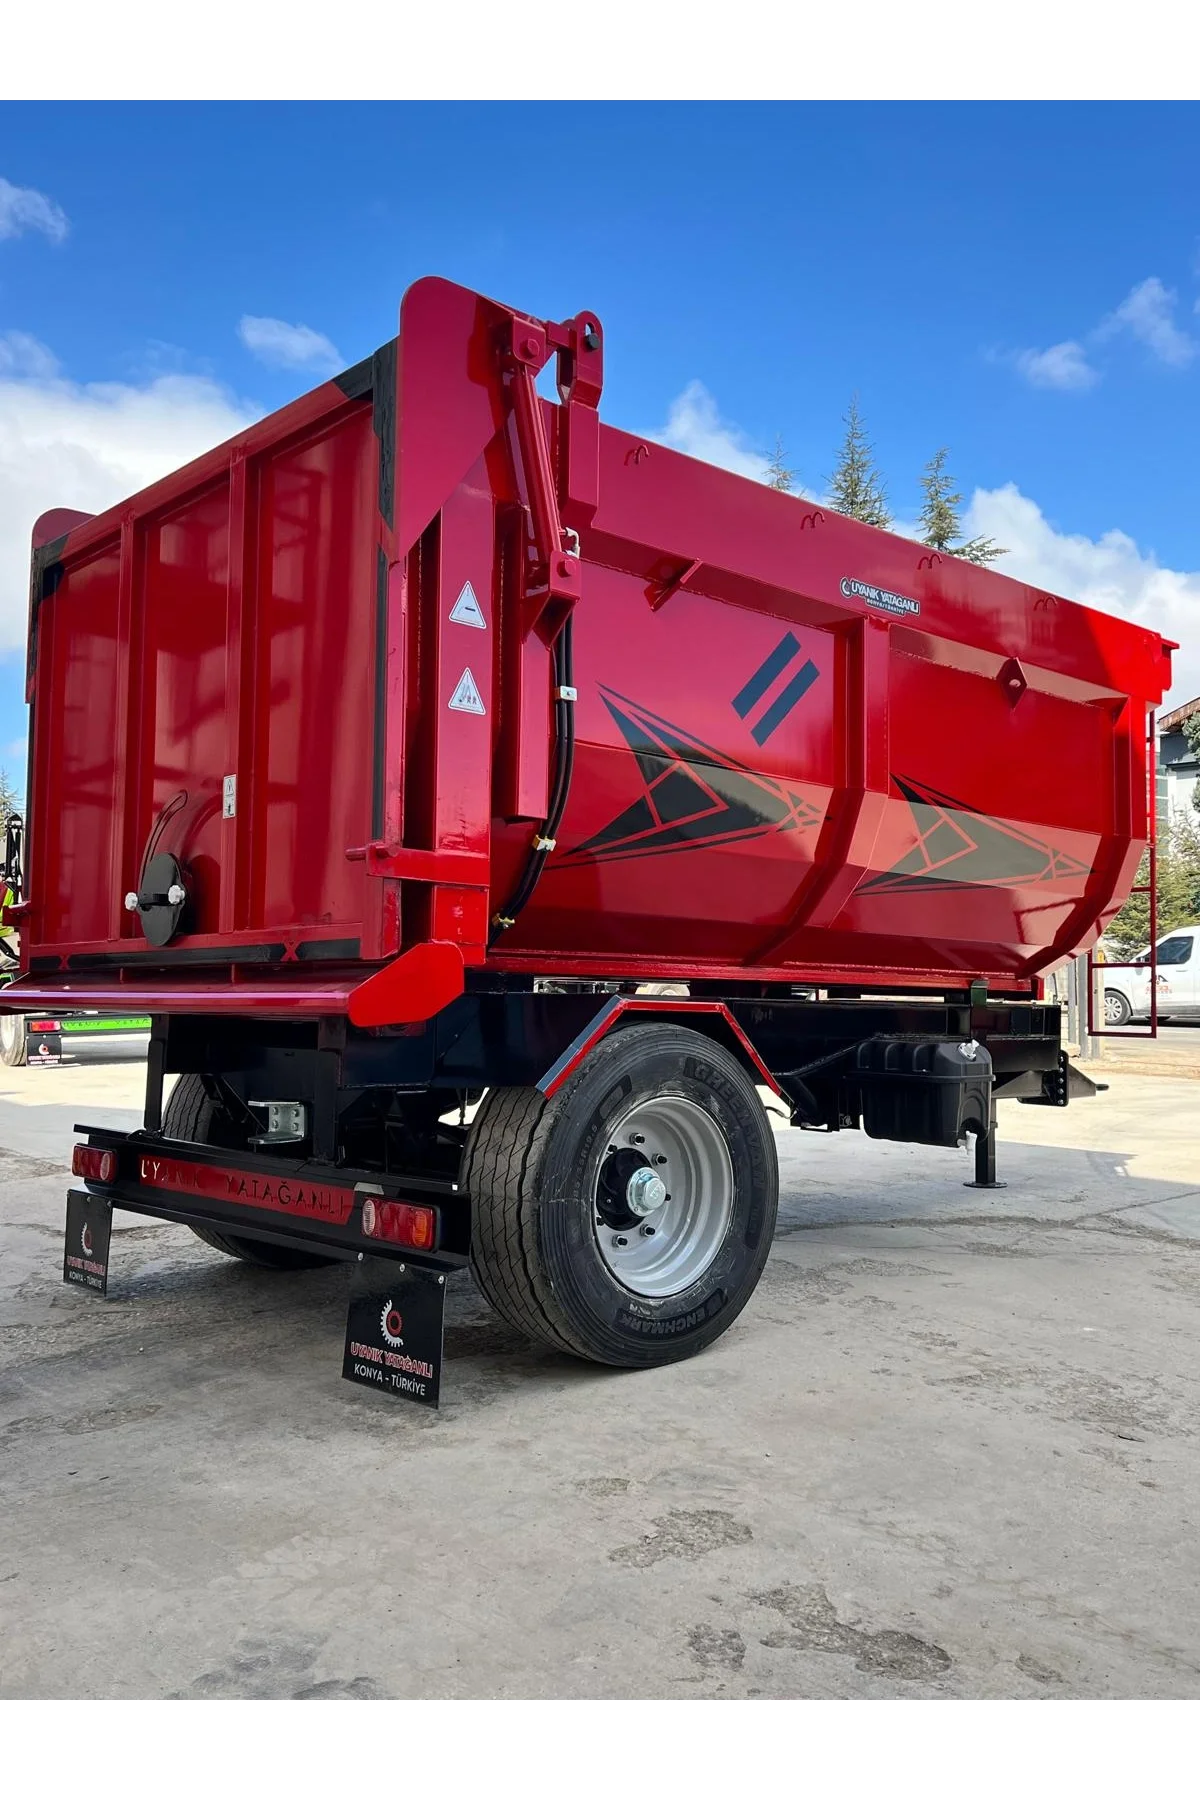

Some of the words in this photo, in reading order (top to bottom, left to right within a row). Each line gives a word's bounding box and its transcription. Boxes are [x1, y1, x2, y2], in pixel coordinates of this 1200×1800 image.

[851, 581, 880, 600] UYANIK
[223, 1174, 345, 1216] YATAĞANLI
[350, 1341, 383, 1364] UYANIK
[354, 1363, 383, 1383] KONYA
[391, 1374, 426, 1396] TÜRKİYE
